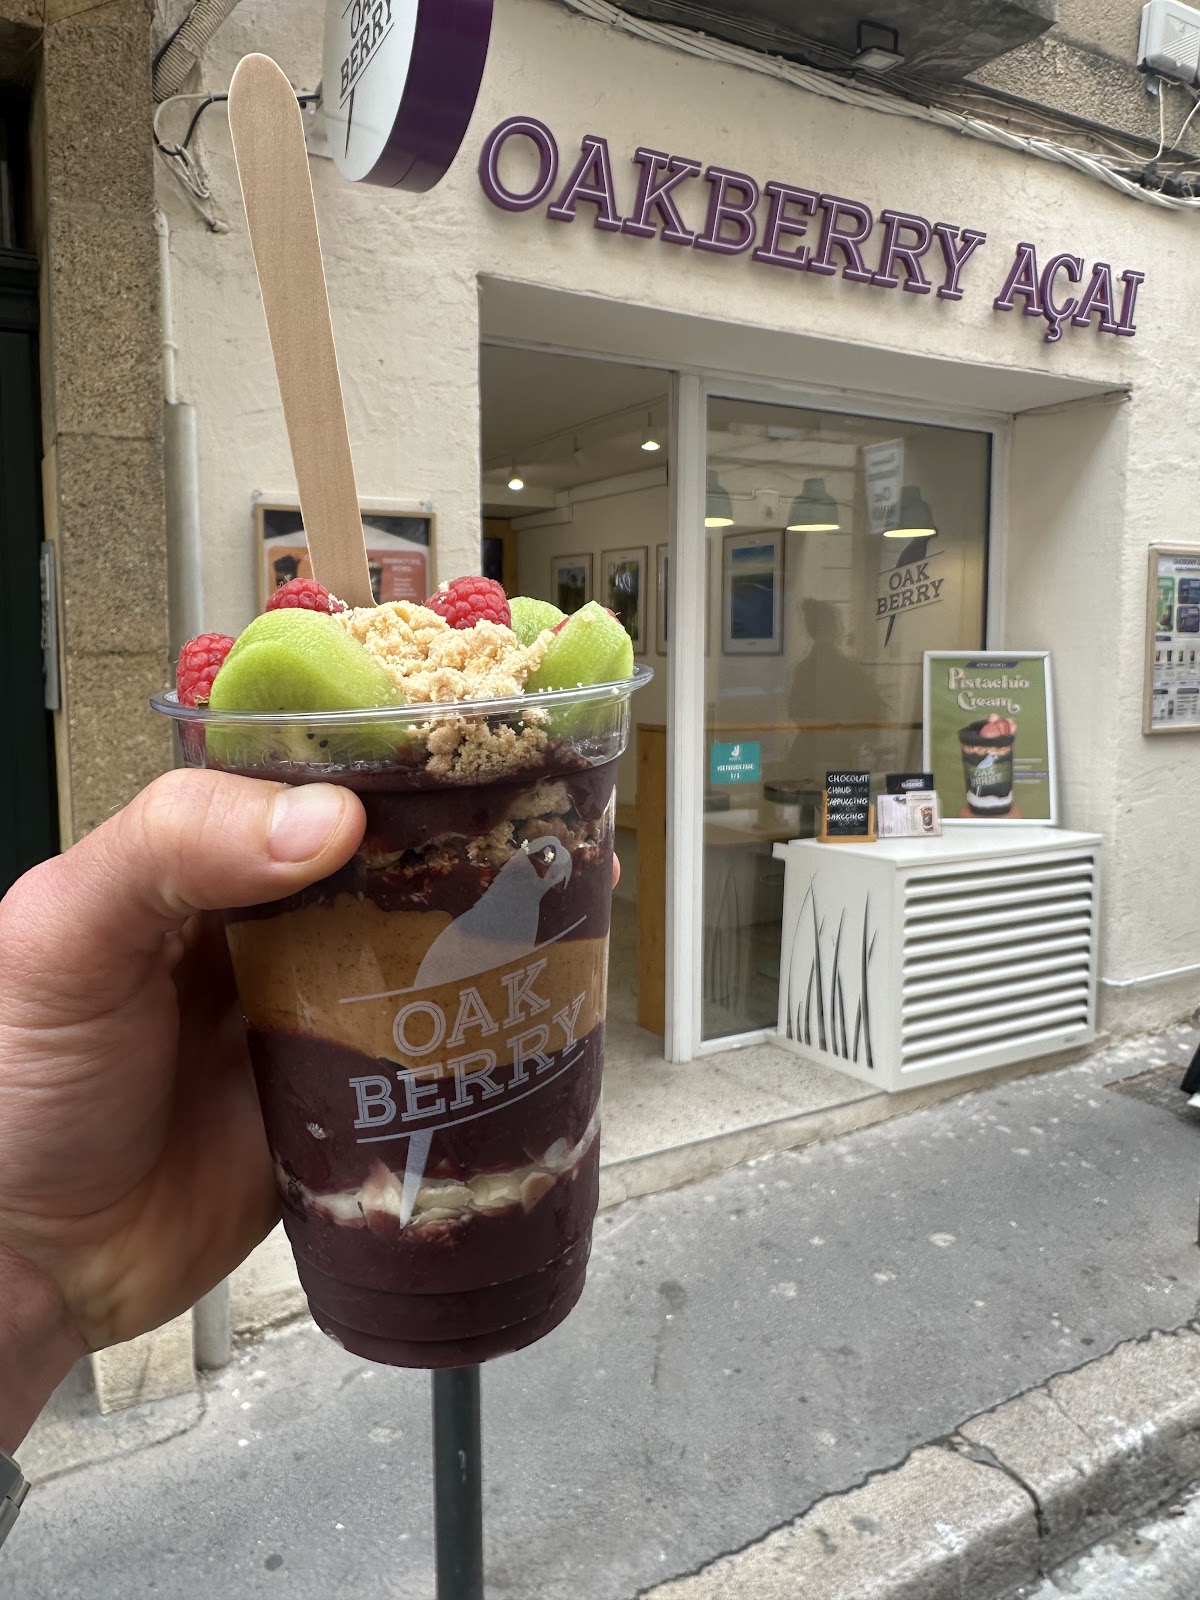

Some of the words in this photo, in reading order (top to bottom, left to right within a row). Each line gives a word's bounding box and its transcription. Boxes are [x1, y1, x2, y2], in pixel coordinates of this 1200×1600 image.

[478, 115, 987, 301] OAKBERRY
[993, 242, 1145, 343] AÇAI
[888, 561, 930, 591] OAK
[875, 577, 944, 616] BERRY
[948, 667, 1030, 690] Pistachio
[957, 690, 1020, 714] Cream
[827, 786, 852, 794] CHAUD
[828, 774, 869, 783] CHOCOLAT
[392, 957, 551, 1057] OAK
[348, 990, 586, 1129] BERRY
